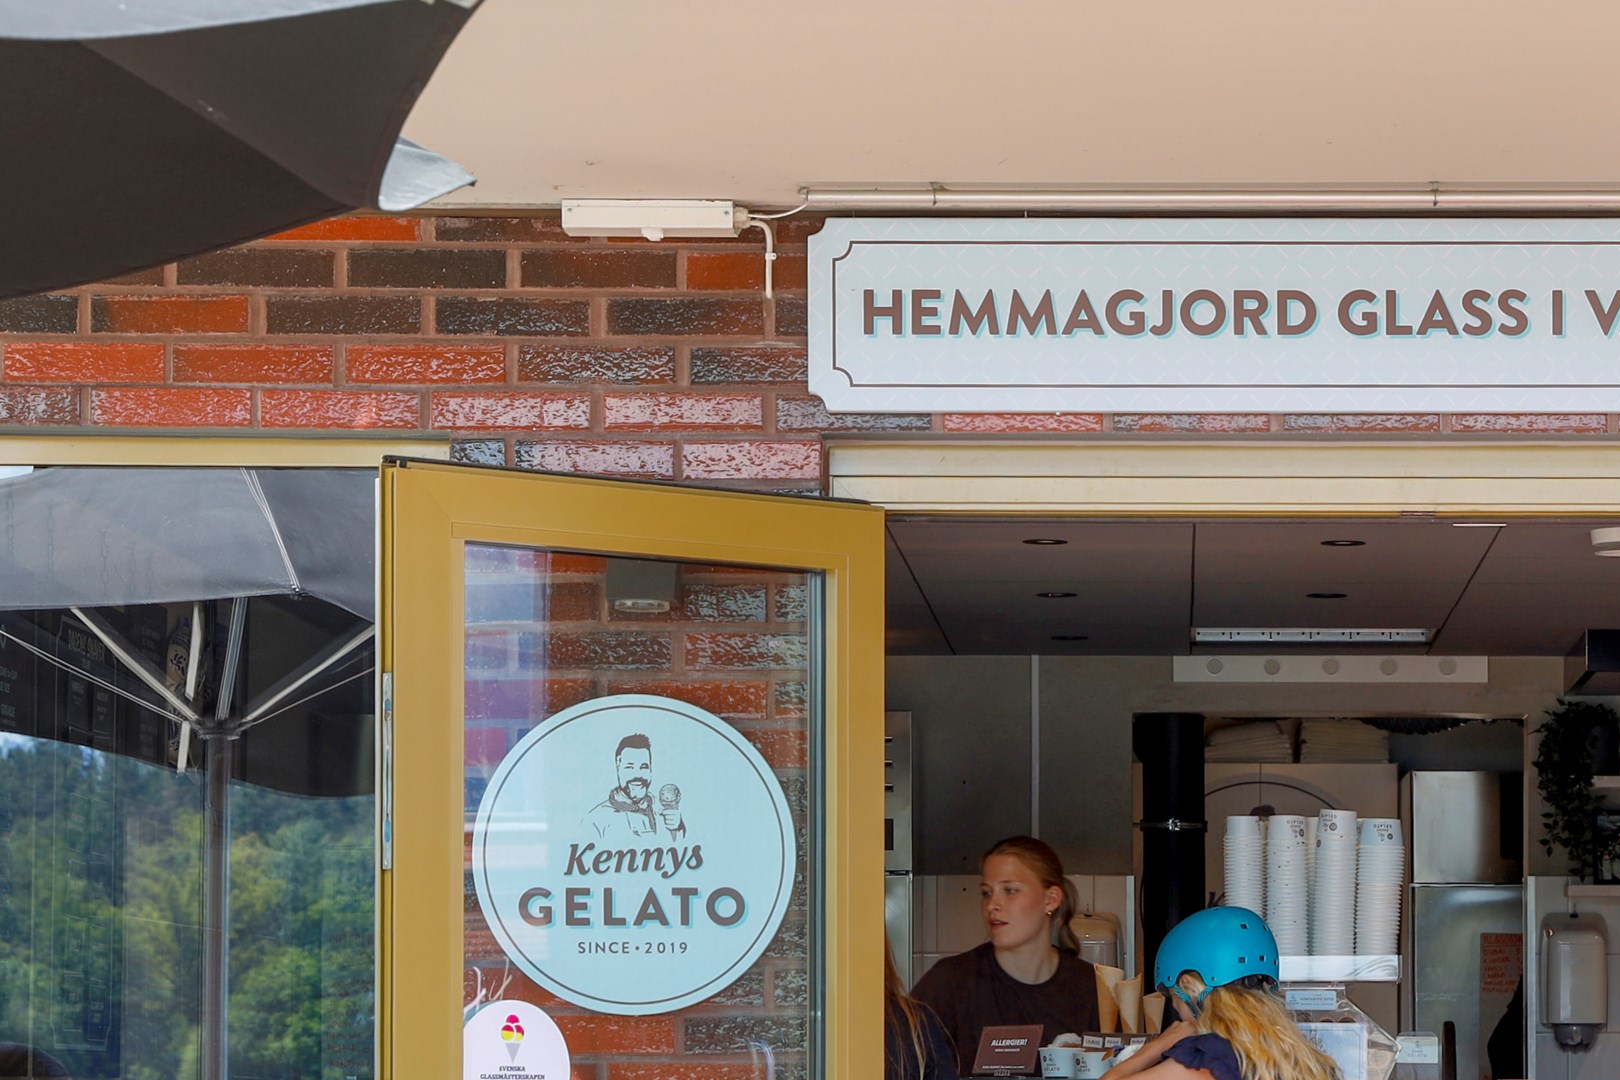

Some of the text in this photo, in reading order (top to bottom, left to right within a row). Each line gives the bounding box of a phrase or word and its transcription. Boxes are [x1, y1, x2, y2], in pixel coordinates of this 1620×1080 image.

[862, 288, 1319, 338] HEMMAGJORD
[1337, 288, 1530, 338] GLASS
[1550, 288, 1567, 338] I
[563, 842, 704, 879] Kennys
[518, 886, 748, 929] GELATO
